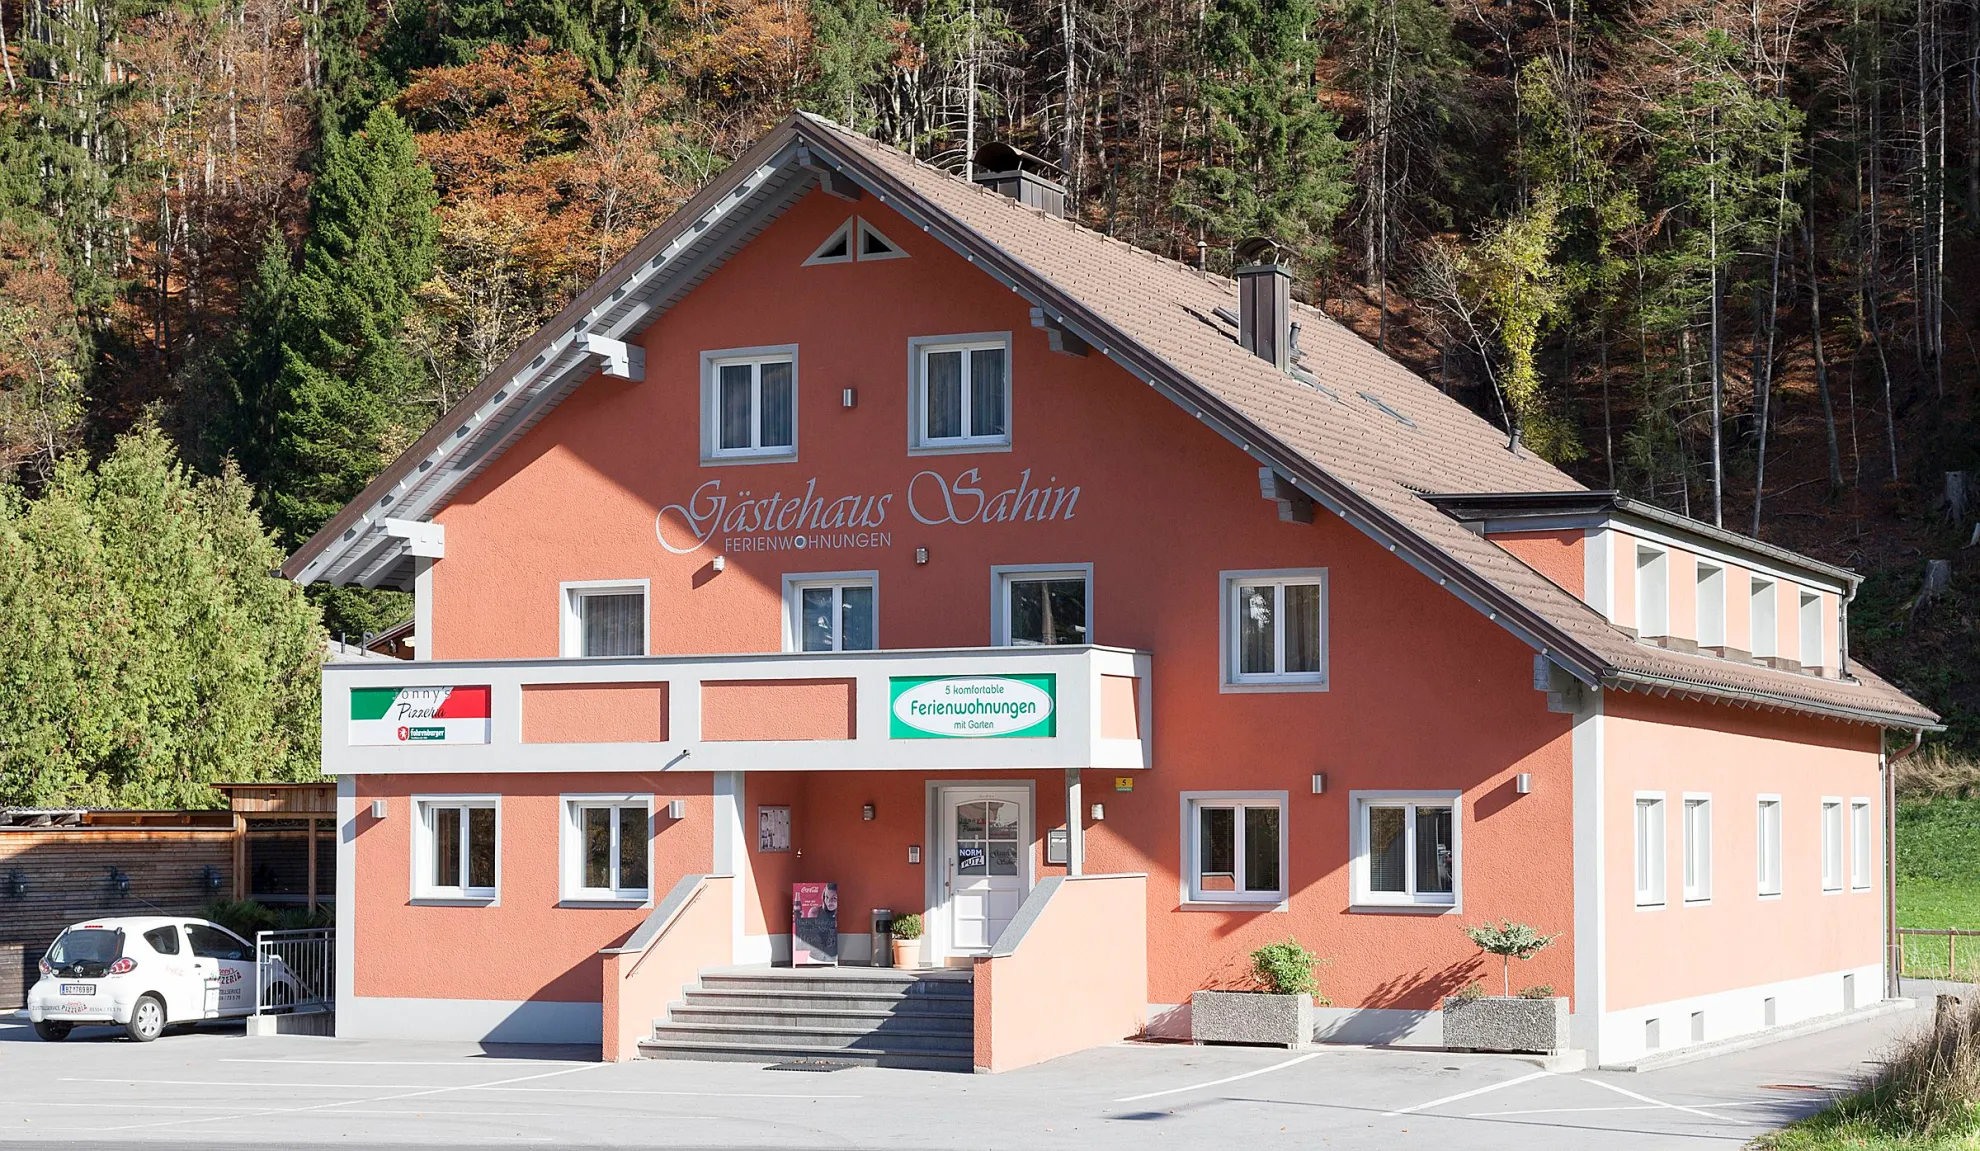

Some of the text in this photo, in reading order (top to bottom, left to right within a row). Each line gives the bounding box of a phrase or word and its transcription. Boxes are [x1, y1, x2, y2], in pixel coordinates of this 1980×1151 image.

[655, 468, 1081, 554] Gästehaus Sahin
[724, 531, 892, 553] FERIENWOHNUNGEN
[944, 684, 1005, 695] 5 komfortable
[397, 702, 446, 721] Pizzeria
[910, 698, 1036, 719] Ferienwohnungen
[953, 720, 994, 729] mit Garten
[1122, 779, 1127, 787] 5
[959, 848, 982, 857] NORM
[963, 856, 982, 867] PUTZ
